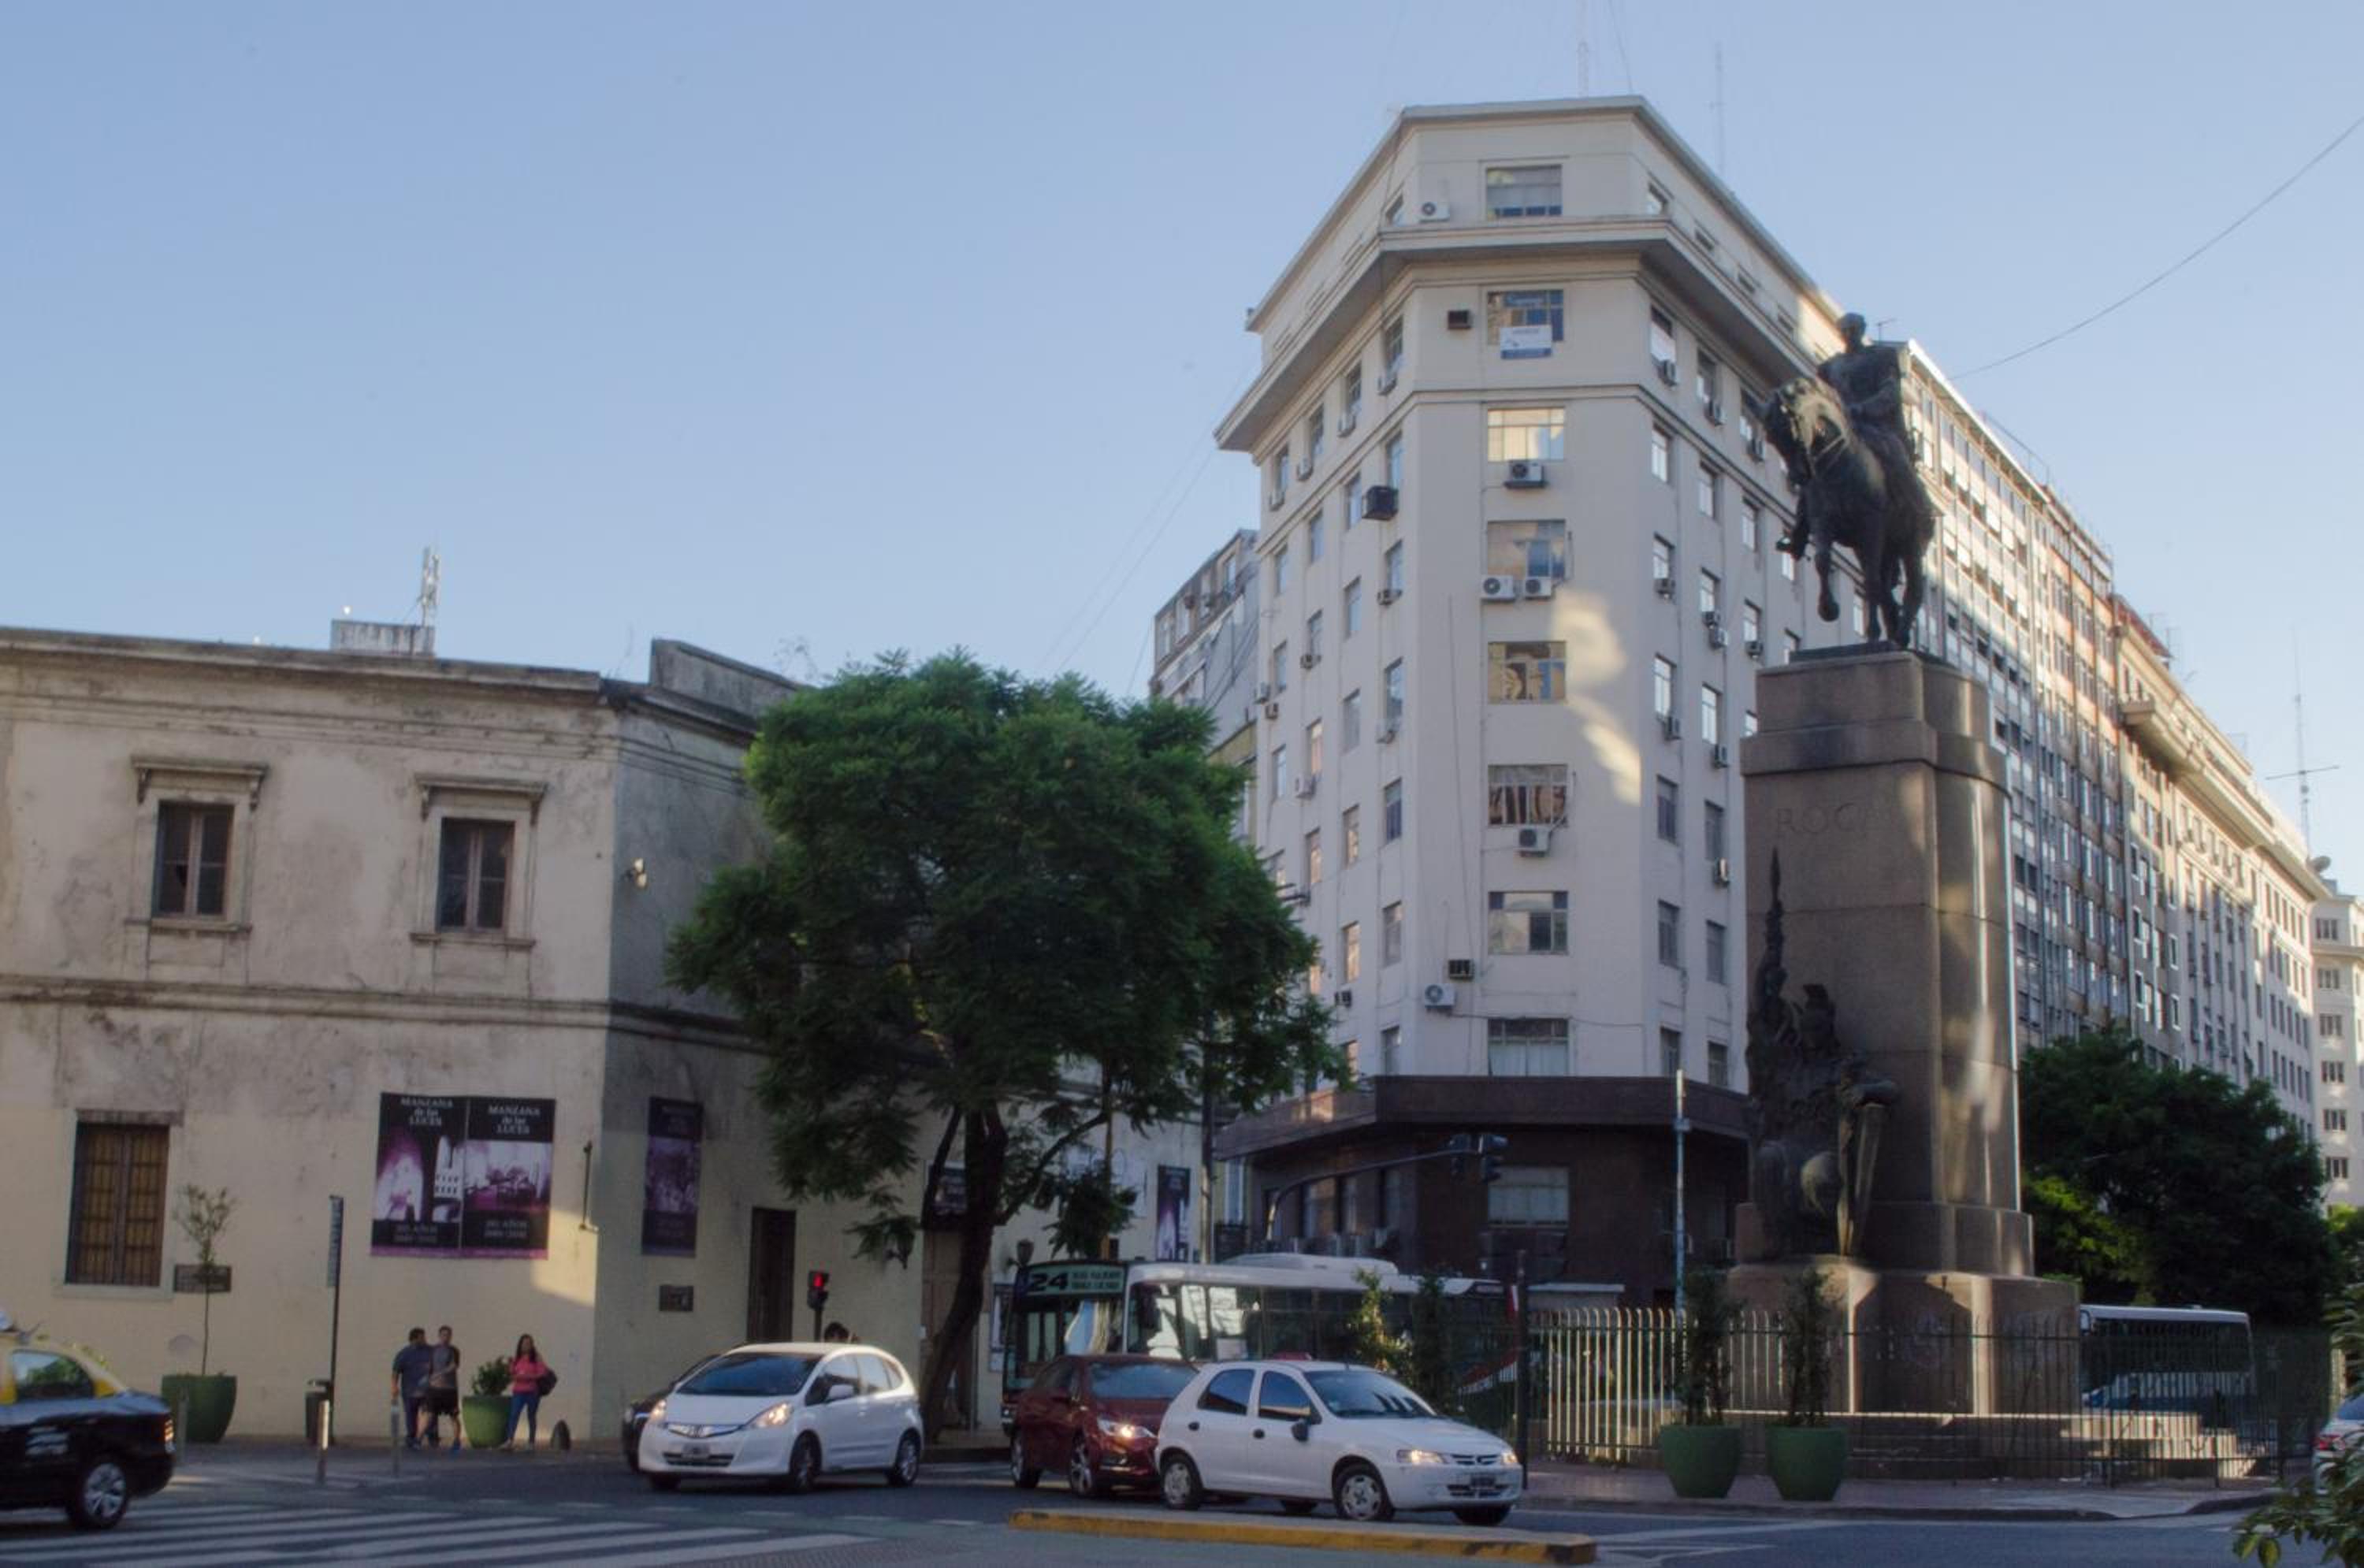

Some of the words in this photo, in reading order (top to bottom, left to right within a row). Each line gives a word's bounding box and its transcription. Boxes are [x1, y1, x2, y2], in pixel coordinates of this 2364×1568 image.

[400, 1096, 453, 1108] MANZANA
[488, 1105, 540, 1116] MANZANA
[409, 1116, 442, 1126] LUCES
[496, 1124, 530, 1135] LUCES
[1031, 1273, 1068, 1291] 24
